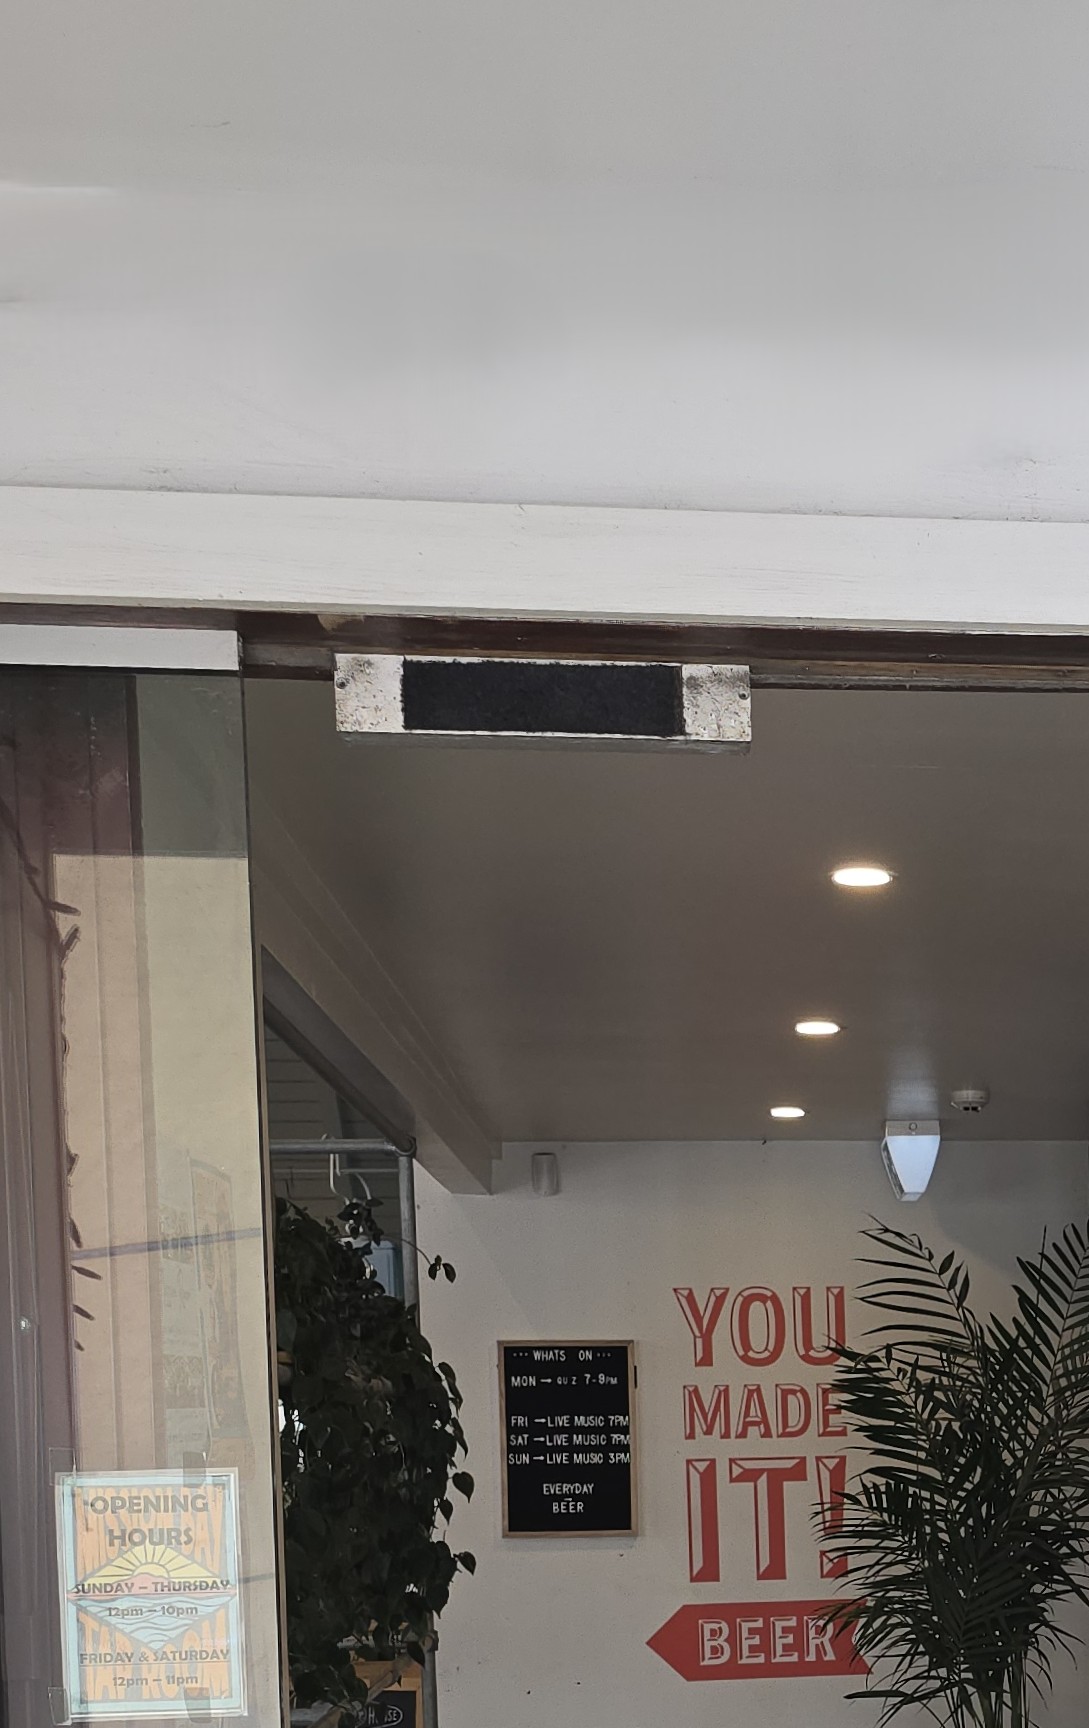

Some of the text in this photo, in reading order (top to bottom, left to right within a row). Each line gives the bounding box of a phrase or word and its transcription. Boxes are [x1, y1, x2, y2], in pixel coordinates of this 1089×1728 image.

[672, 1285, 847, 1368] YOU
[533, 1350, 593, 1361] WHATS ON
[511, 1376, 536, 1387] MON
[682, 1382, 848, 1440] MADE
[511, 1415, 629, 1427] FRI LIVE MUSIC 7PM
[509, 1434, 631, 1446] SAT LIVE MUSIC 7PM
[508, 1453, 631, 1465] SUN LIVE MUSIC 3PM
[543, 1483, 594, 1495] EVERYDAY
[91, 1494, 208, 1515] OPENING
[552, 1502, 584, 1513] BEER
[685, 1456, 849, 1583] IT!
[108, 1526, 193, 1547] HOURS
[74, 1580, 230, 1594] SUNDAY THURSDAY
[107, 1605, 198, 1618] 12pm 10pm
[699, 1616, 836, 1666] BEER
[80, 1649, 230, 1665] FRIDAY & SATURDAY
[112, 1675, 198, 1688] 12pm 11pm
